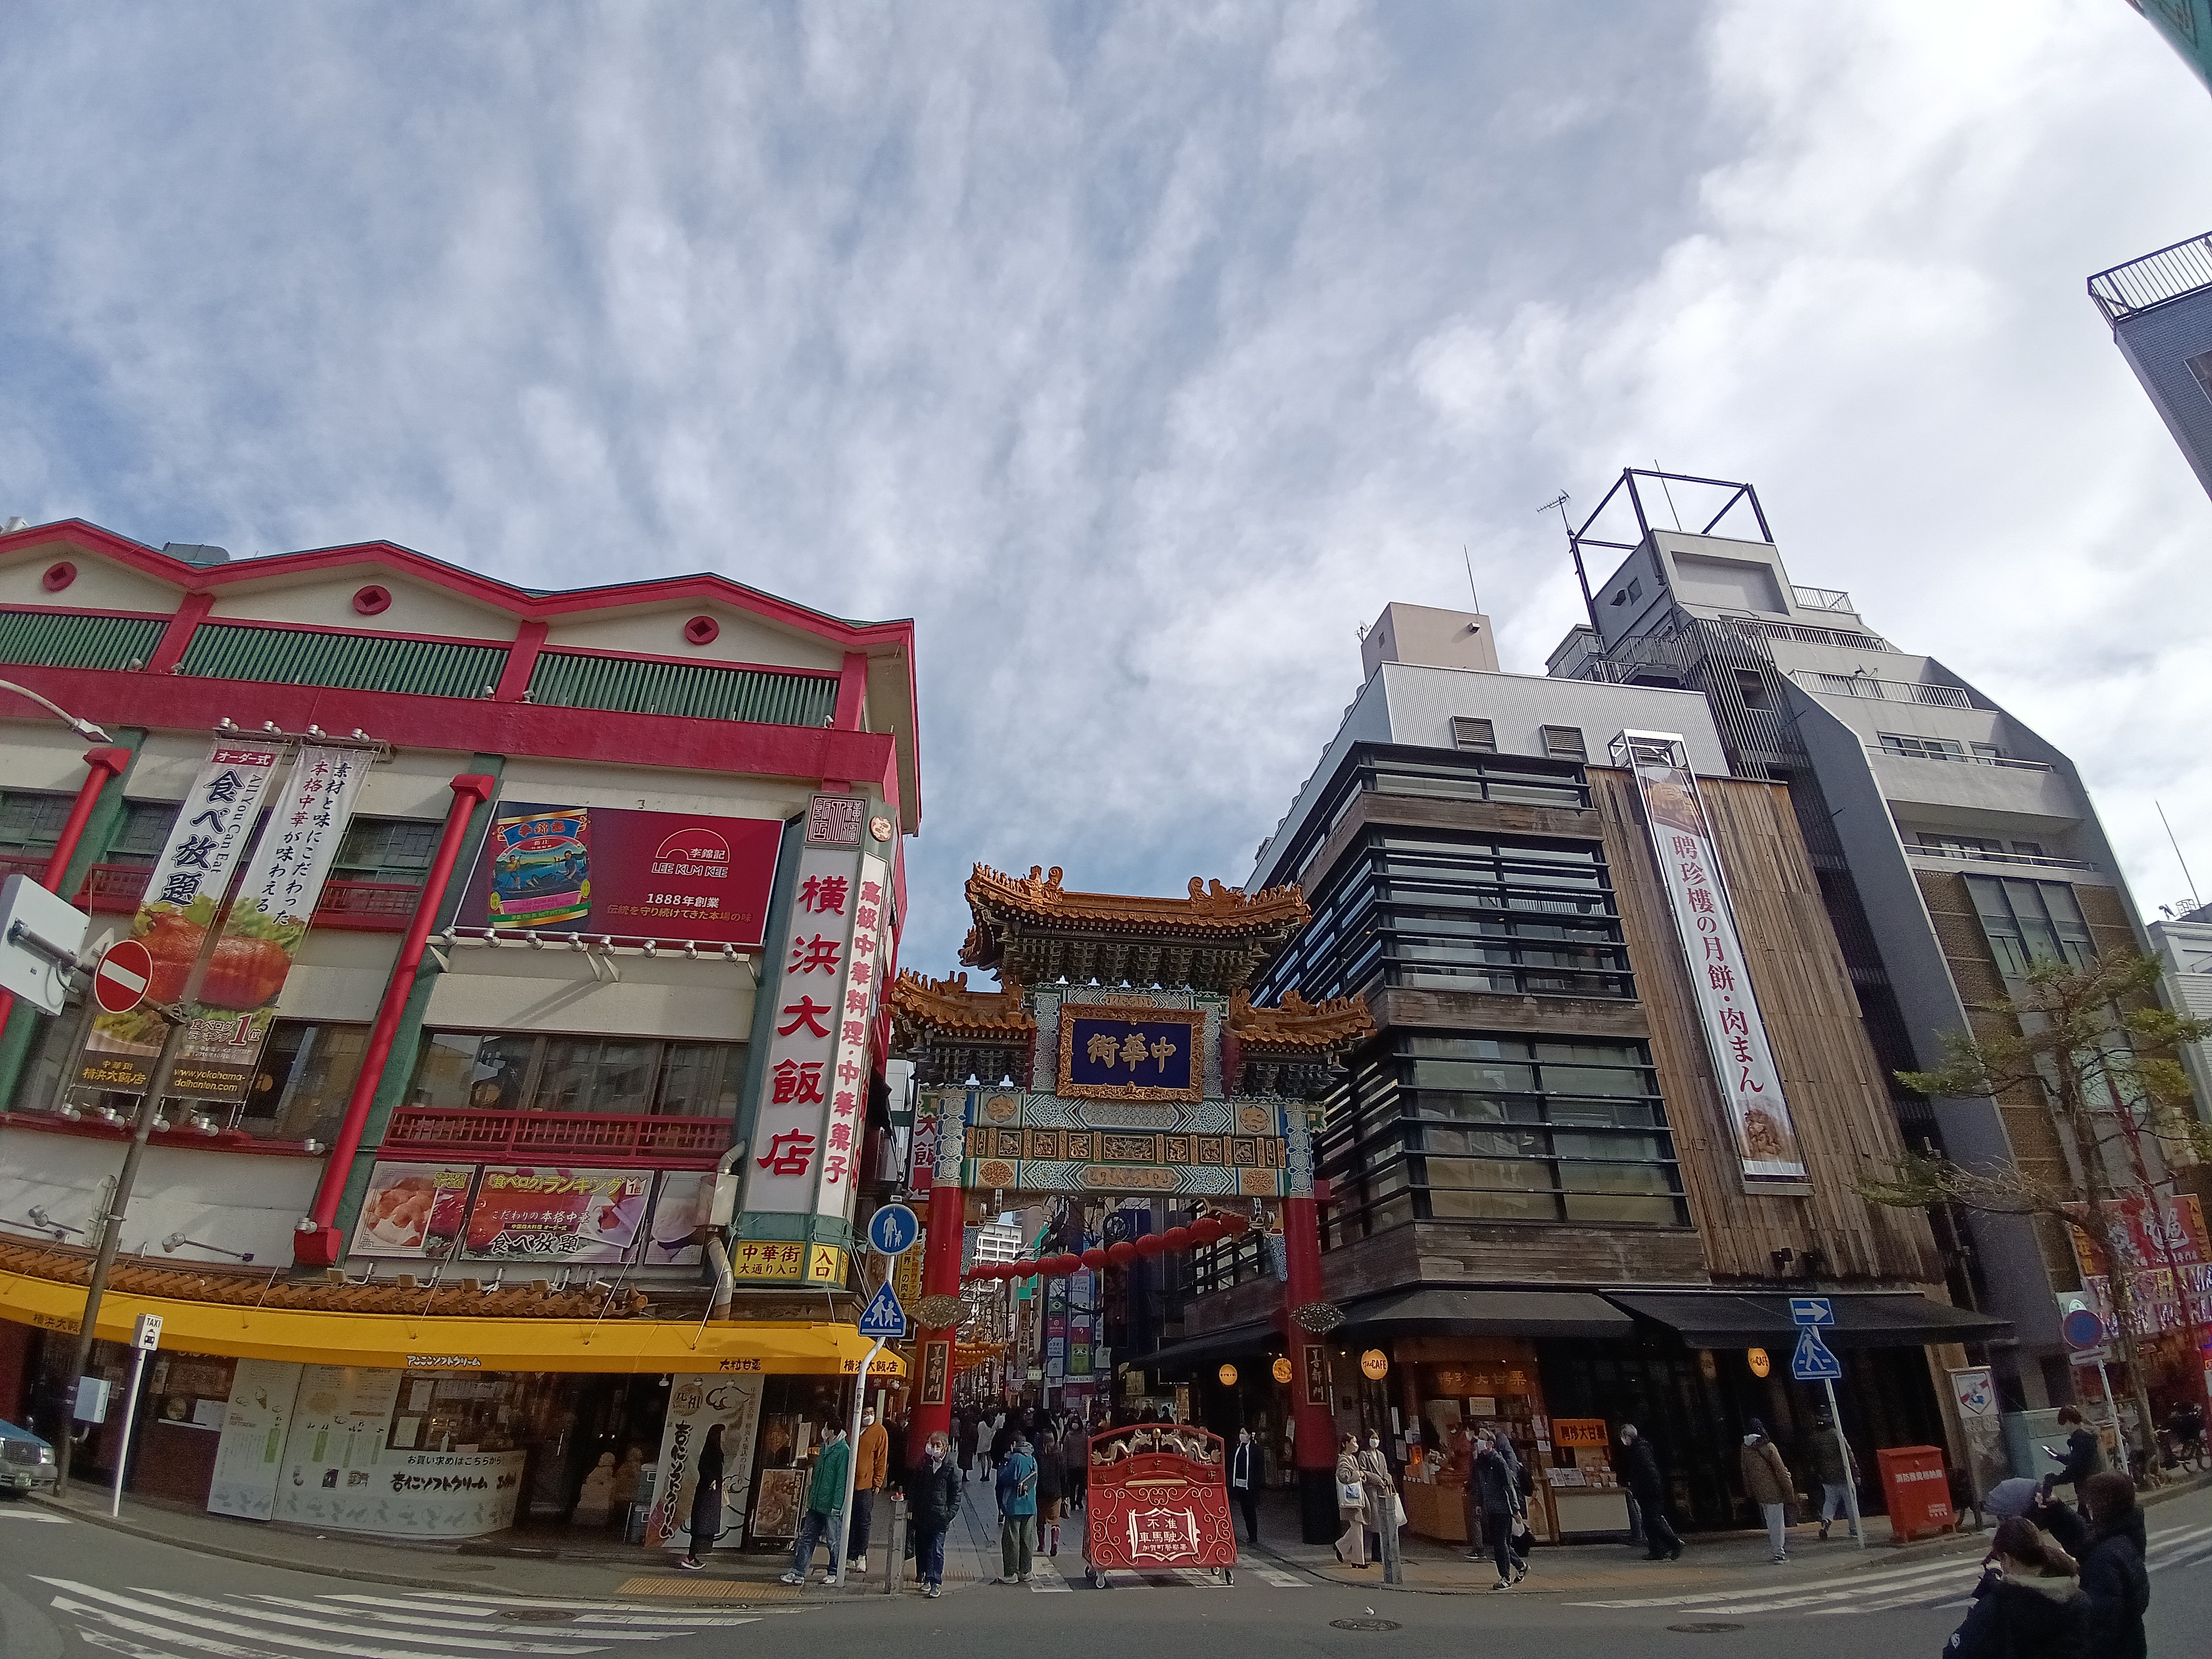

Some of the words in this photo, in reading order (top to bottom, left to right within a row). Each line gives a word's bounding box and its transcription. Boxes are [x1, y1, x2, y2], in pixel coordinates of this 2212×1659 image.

[216, 751, 272, 766] オーダー式
[245, 774, 264, 793] All
[232, 796, 255, 822] You
[154, 769, 246, 907] 食べ放題
[220, 824, 241, 849] Can
[256, 761, 329, 912] 本格中華が味わえる
[273, 762, 352, 926] 素材と味にこだわった
[210, 853, 230, 874] Eat
[689, 848, 726, 860] 李錦記
[651, 862, 674, 874] LEE
[675, 864, 703, 876] KUM
[704, 866, 729, 878] KEE
[646, 893, 720, 908] 1888年創業
[606, 903, 754, 923] 伝統を守り続けてきた本場の味
[1670, 835, 1764, 1094] 聘珍樓の月餅・肉まん
[189, 1018, 237, 1033] 食べログ
[756, 874, 850, 1177] 横浜大飯店
[823, 879, 882, 1184] 高級中華料理・中華菓子
[188, 1030, 231, 1043] ランキング
[1087, 1033, 1177, 1073] 中華街
[543, 1176, 625, 1195] ランキング
[628, 1183, 642, 1194] 1位
[491, 1231, 580, 1254] 食べ放題
[742, 1244, 802, 1263] 中華街
[815, 1248, 834, 1278] 入口
[739, 1263, 798, 1275] 大通り入口
[146, 1318, 161, 1328] TAXI
[719, 1358, 761, 1371] 大粒甘栗
[1371, 1359, 1387, 1370] CAFE
[408, 1455, 501, 1465] お買い求めはこちらから
[1147, 1518, 1178, 1530] 不准
[1139, 1531, 1190, 1543] 車馬駛入
